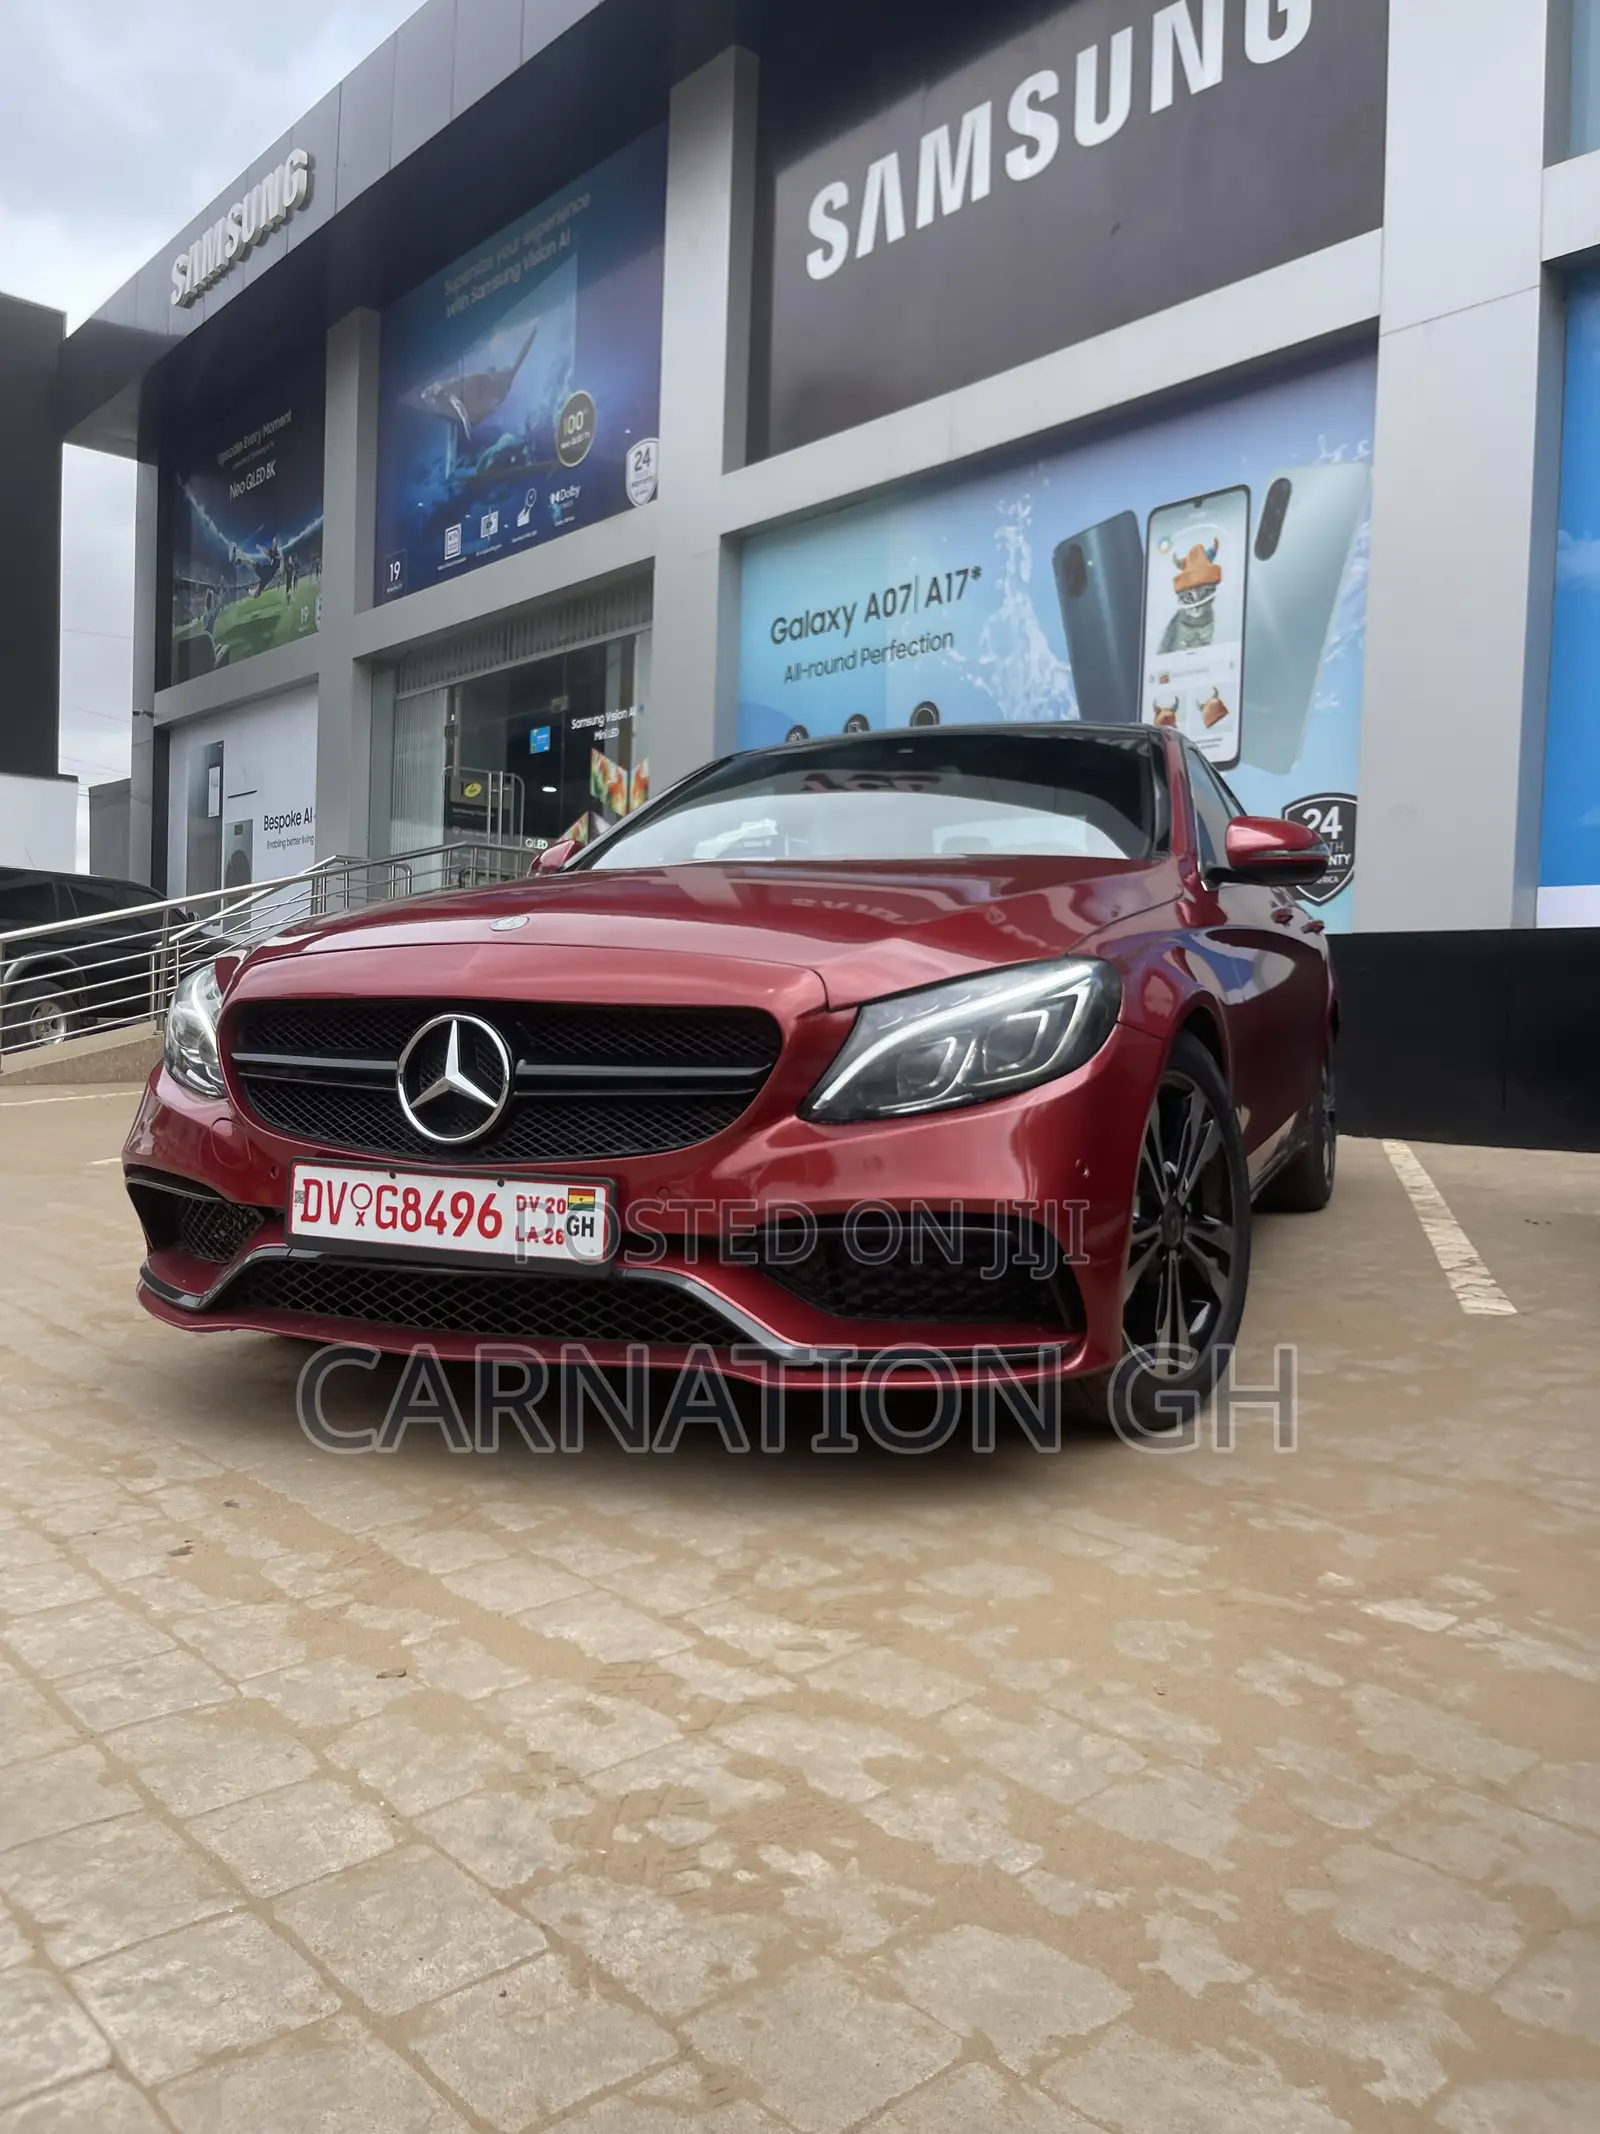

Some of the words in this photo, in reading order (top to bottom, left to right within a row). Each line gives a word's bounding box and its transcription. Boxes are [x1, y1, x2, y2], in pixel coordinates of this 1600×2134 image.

[806, 0, 1312, 280] SAMSUNG
[171, 149, 308, 309] SAMSUNG
[471, 263, 523, 304] Samsung
[559, 226, 571, 251] AI
[634, 447, 652, 472] 24
[229, 480, 246, 501] Neo
[245, 466, 266, 491] QLED
[266, 459, 277, 480] 8K
[560, 485, 582, 501] Dolby
[390, 560, 401, 582] 19
[770, 603, 858, 645] Galaxy
[784, 650, 857, 684] All-round
[861, 632, 954, 667] Perfection
[571, 714, 606, 730] Samsung
[605, 708, 628, 722] Vision
[263, 810, 302, 834] Bespoke
[1302, 806, 1342, 839] 24
[301, 1178, 348, 1225] DV
[376, 1184, 503, 1240] G8496
[515, 1194, 541, 1212] DV
[545, 1196, 567, 1215] 20
[515, 1225, 539, 1243] LA
[543, 1227, 565, 1245] 26
[566, 1214, 595, 1238] GH
